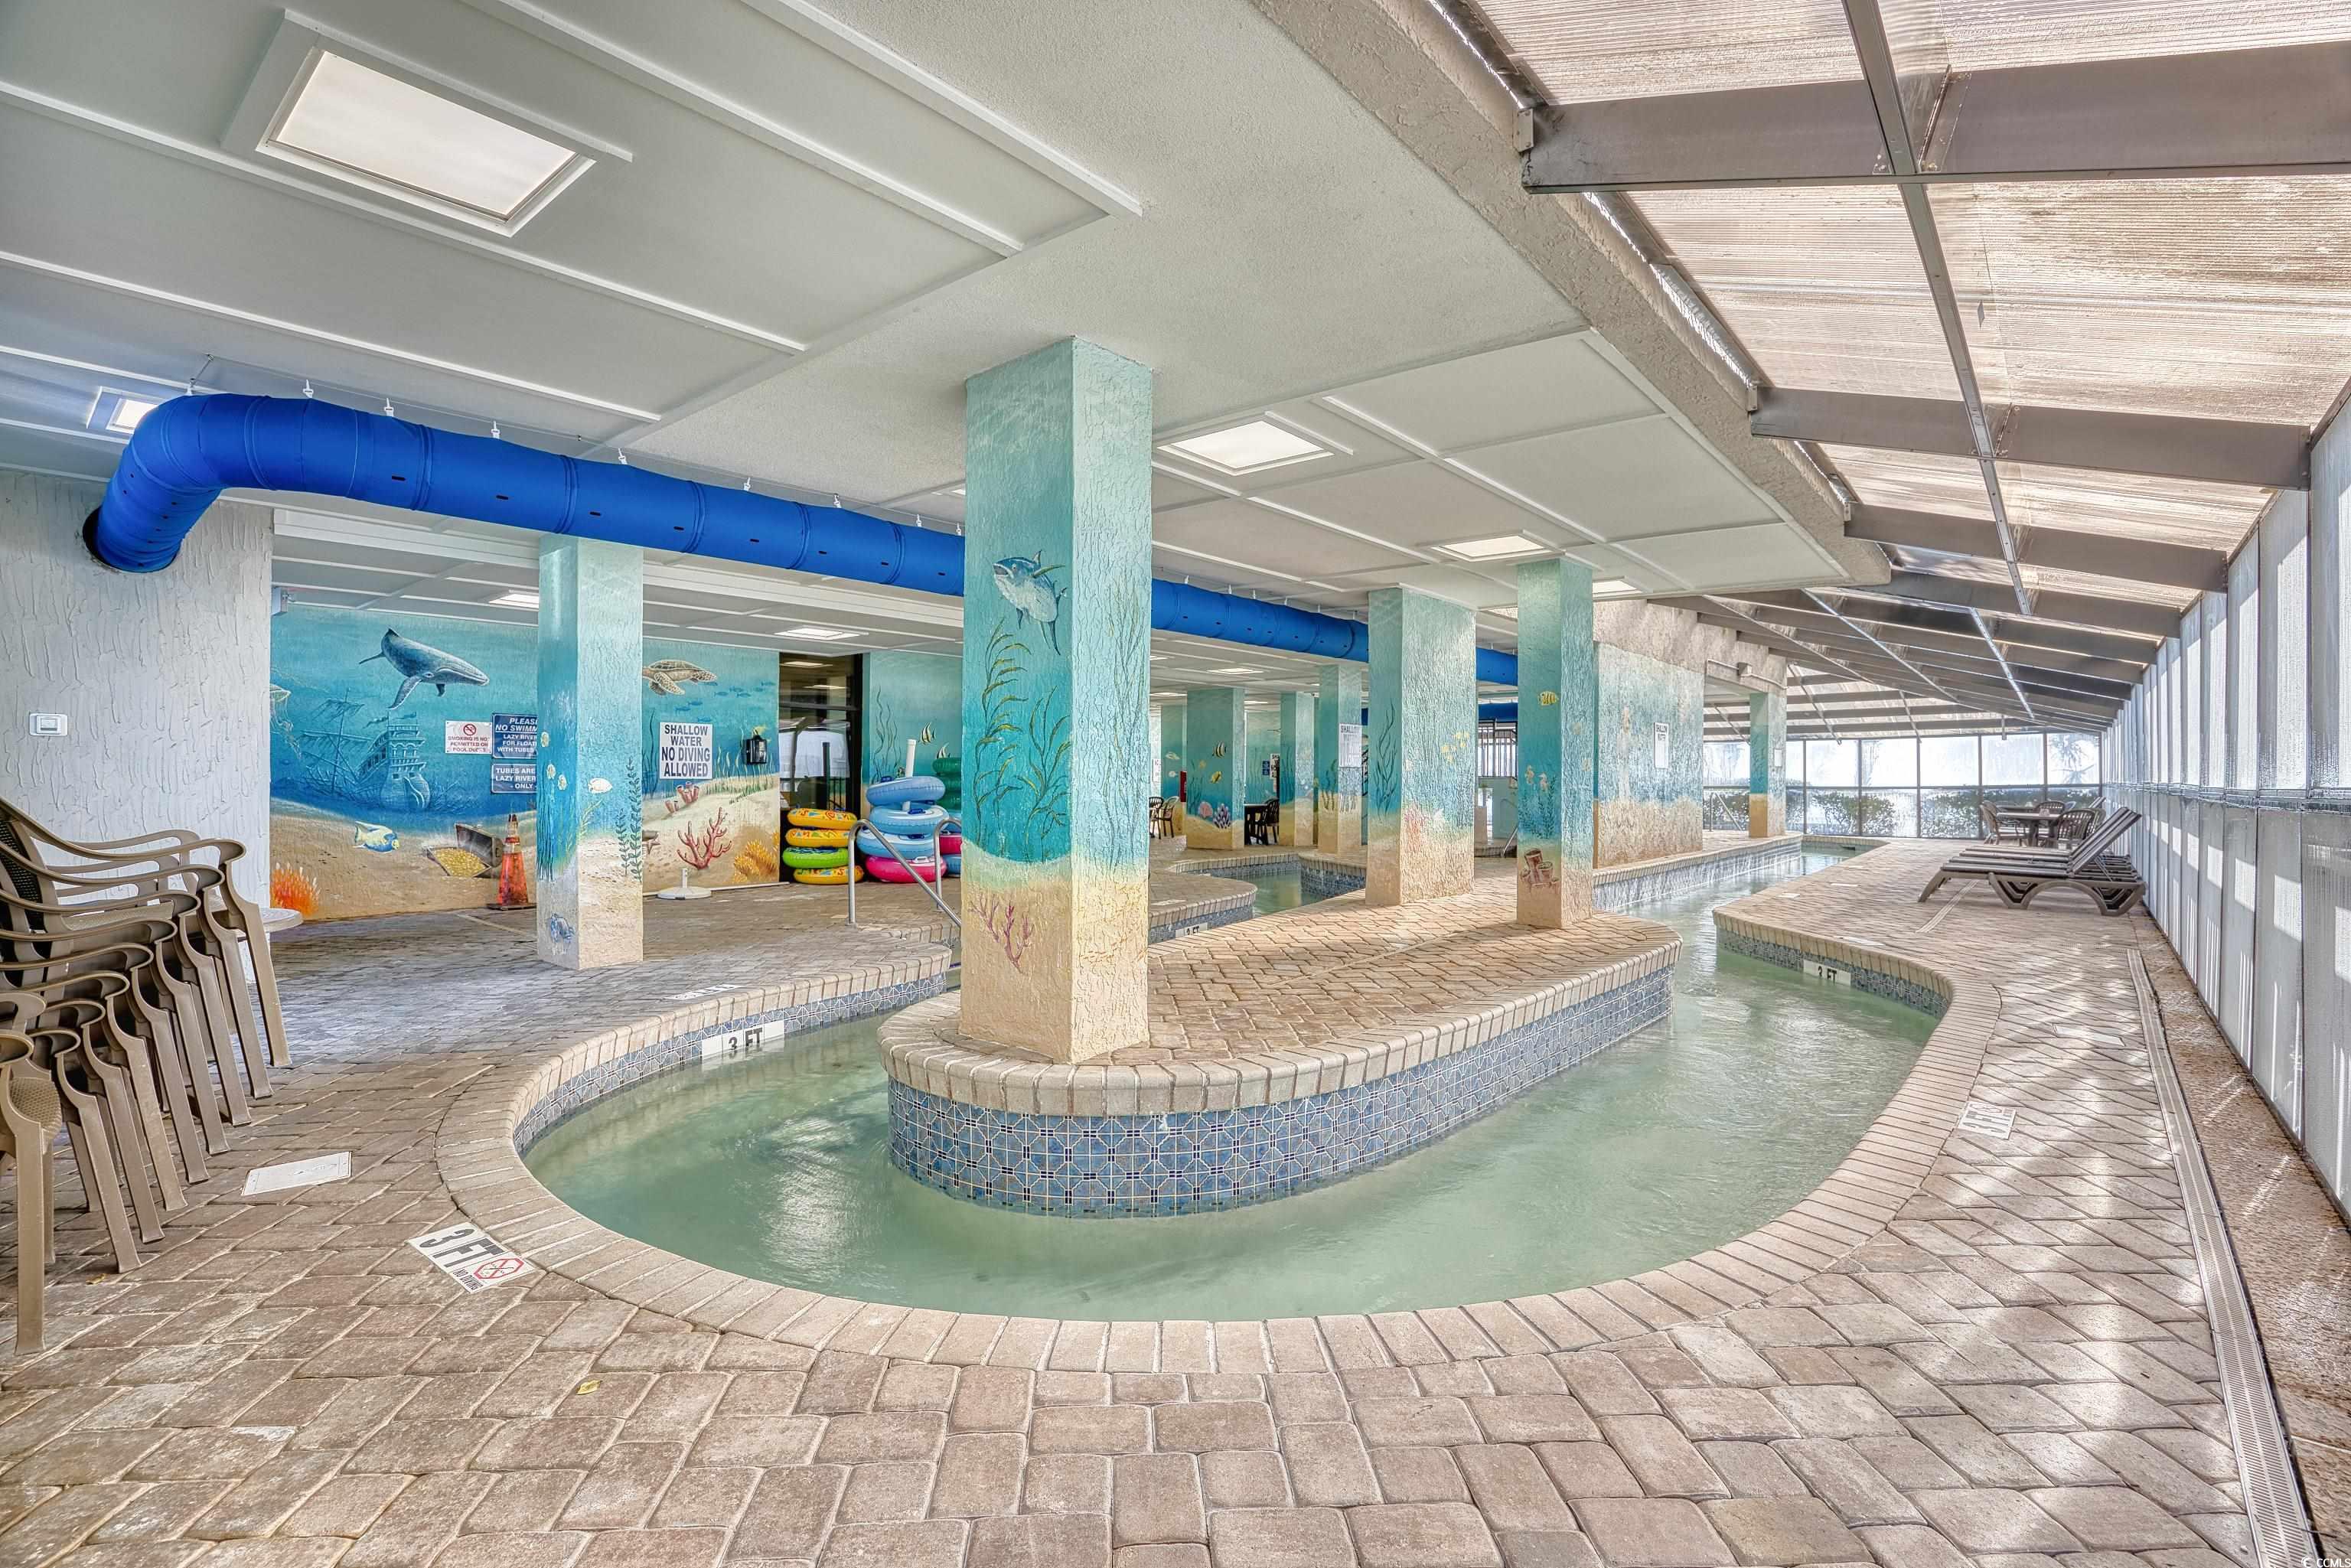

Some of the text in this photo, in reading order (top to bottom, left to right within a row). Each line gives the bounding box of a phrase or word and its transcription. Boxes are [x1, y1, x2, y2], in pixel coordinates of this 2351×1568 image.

[664, 724, 708, 735] SHALLOW
[670, 735, 702, 747] WATER
[661, 746, 710, 762] NO DIVING
[664, 762, 708, 777] ALLOWED
[1827, 968, 1837, 980] FT
[729, 1027, 763, 1050] 3 FT
[419, 1228, 505, 1268] 3 FT
[452, 1269, 484, 1290] NO DIVING
